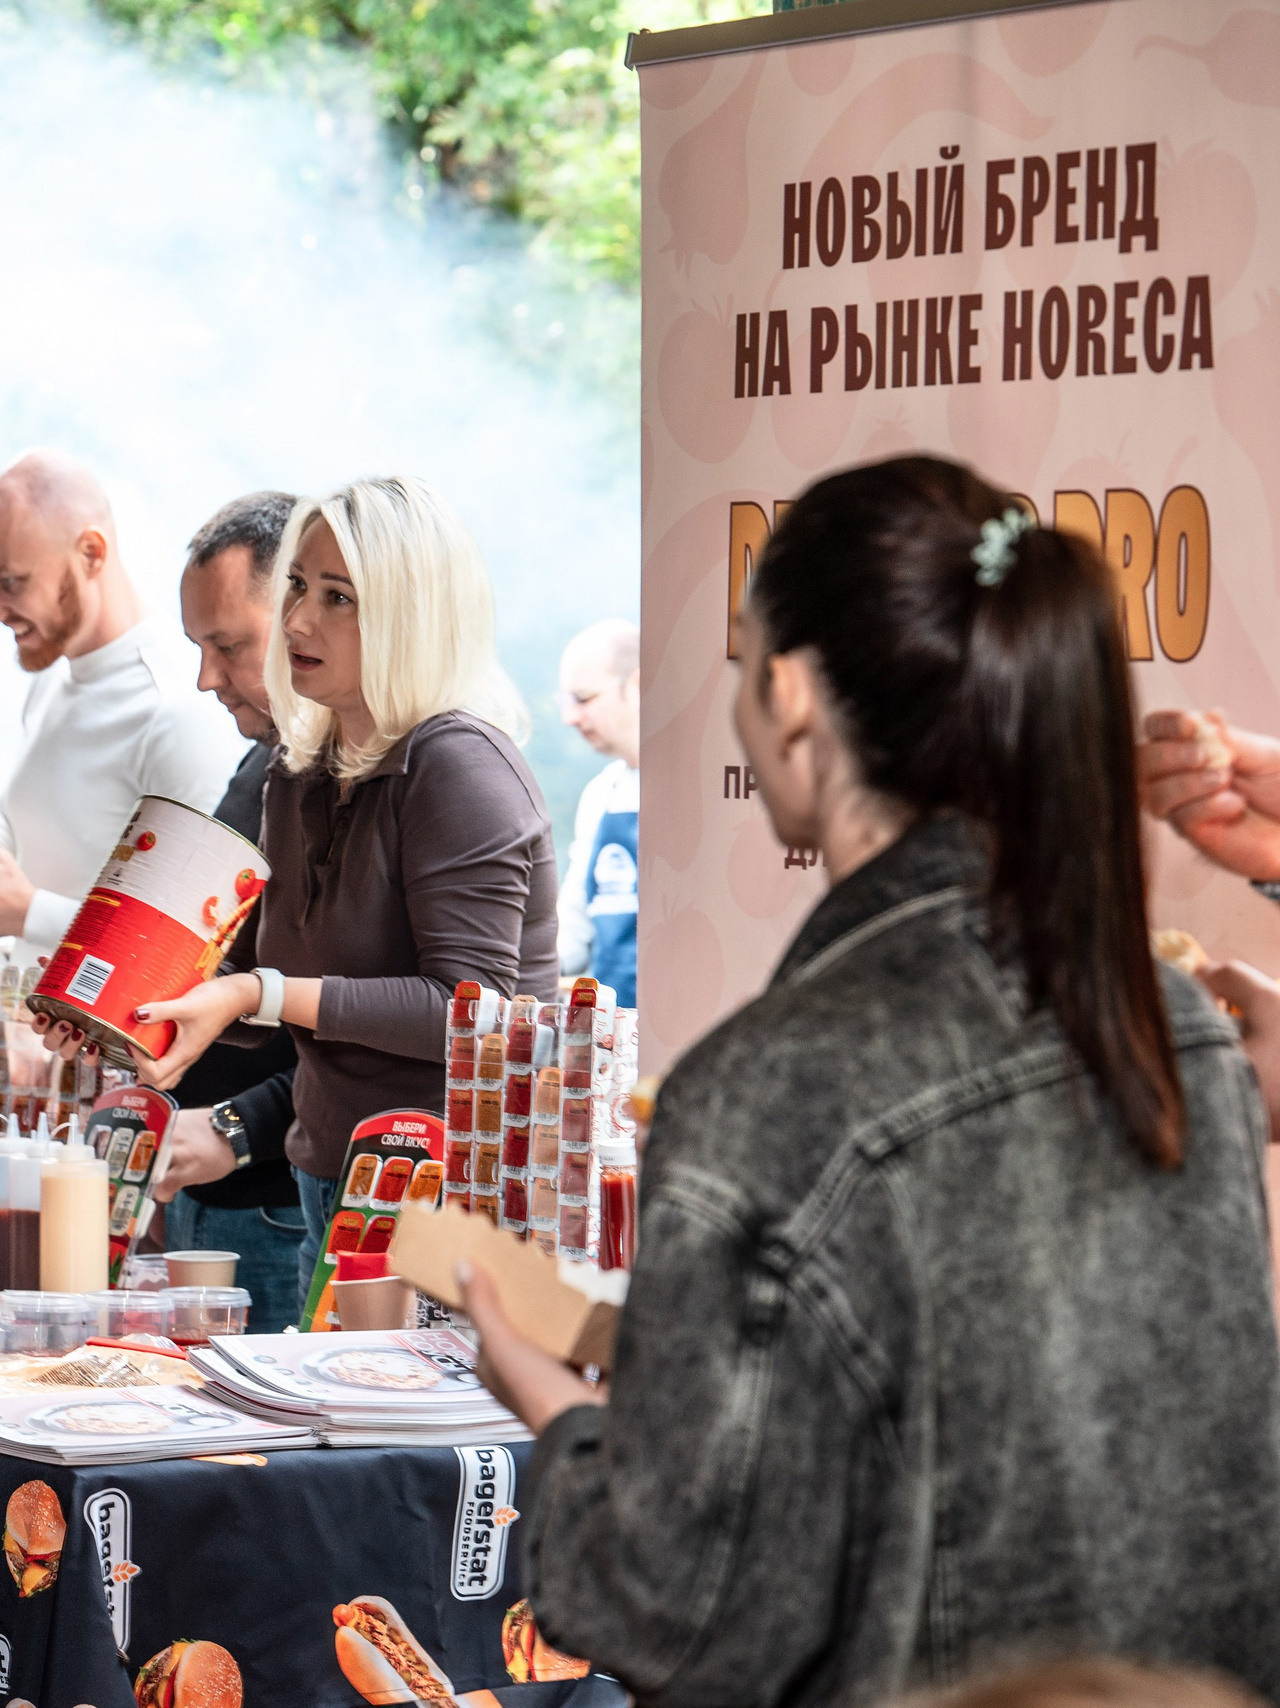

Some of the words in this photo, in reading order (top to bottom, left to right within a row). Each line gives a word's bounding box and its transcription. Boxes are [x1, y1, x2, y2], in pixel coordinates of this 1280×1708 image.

[782, 145, 966, 270] НОВЫЙ
[984, 141, 1160, 254] БРЕНД
[734, 309, 792, 399] НА
[809, 294, 983, 394] РЫНКЕ
[1002, 275, 1215, 382] HORECA
[381, 1132, 405, 1147] СВОЙ
[405, 1136, 431, 1149] ВКУС!
[392, 1120, 428, 1135] ВЫБЕРИ
[457, 1501, 474, 1588] FOODSERVICE
[467, 1449, 496, 1587] bagerstat
